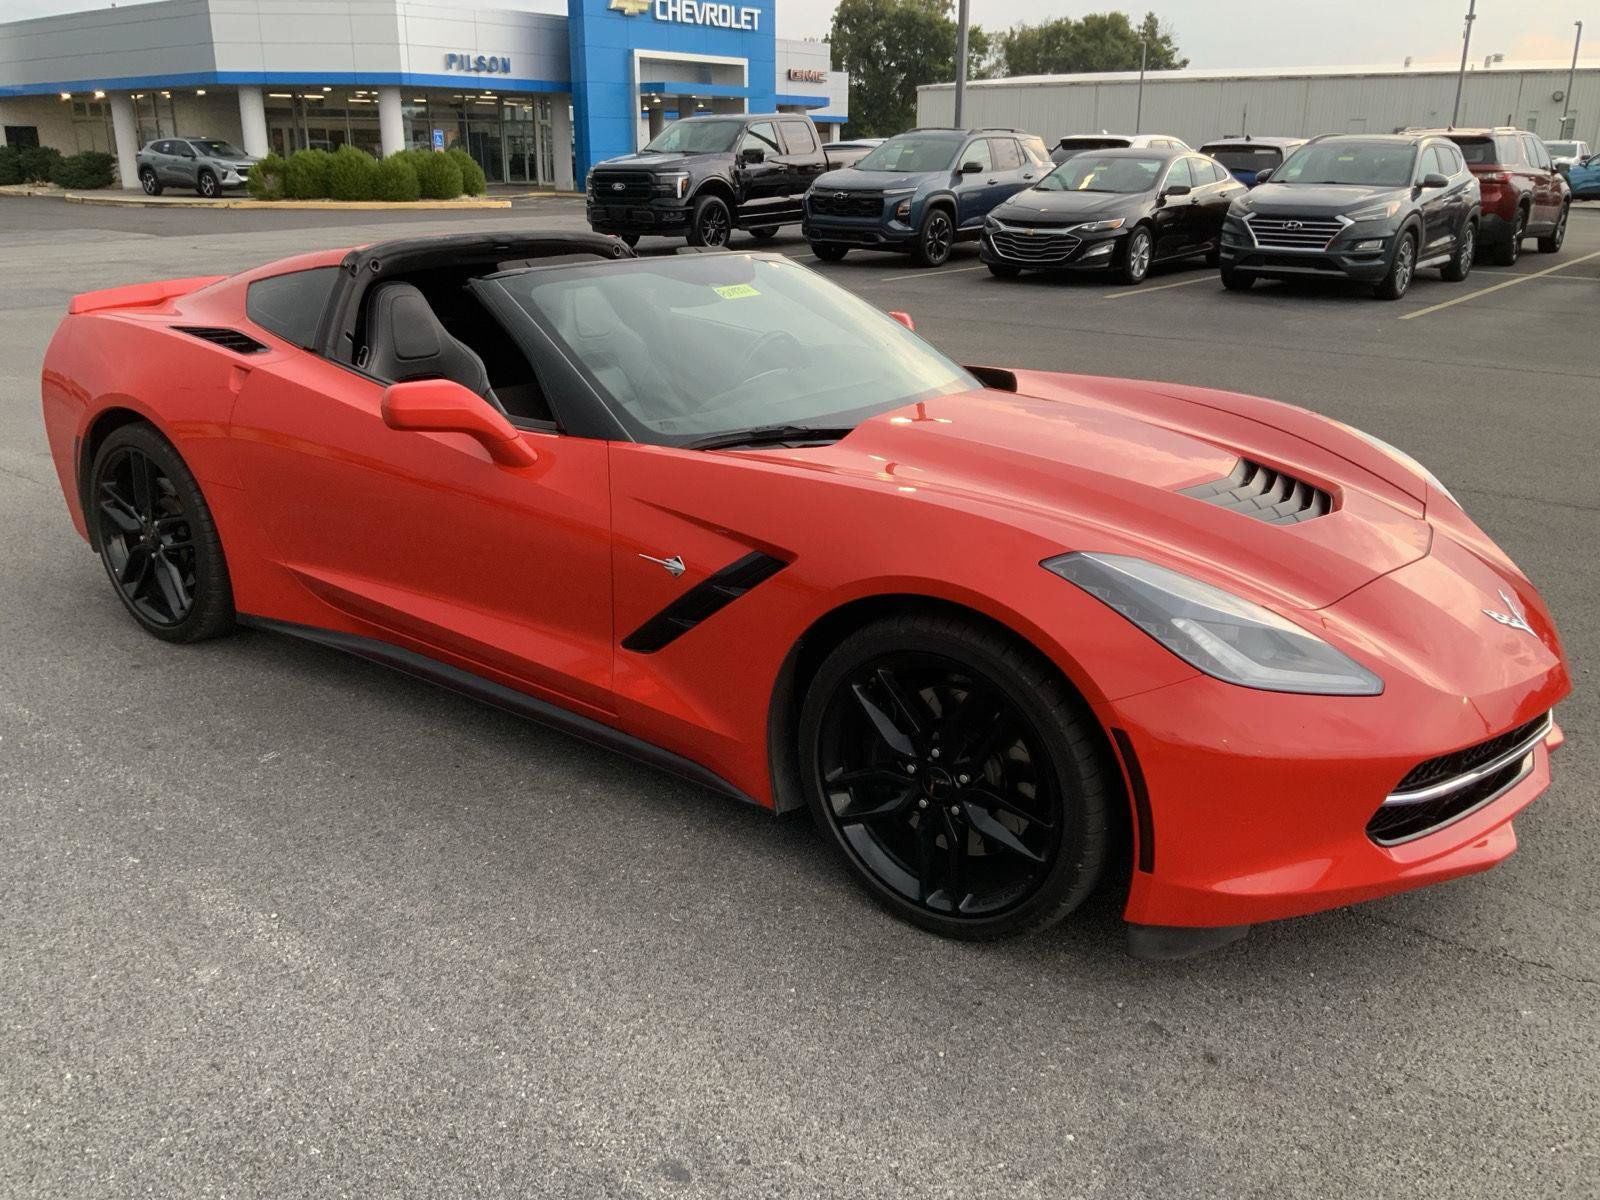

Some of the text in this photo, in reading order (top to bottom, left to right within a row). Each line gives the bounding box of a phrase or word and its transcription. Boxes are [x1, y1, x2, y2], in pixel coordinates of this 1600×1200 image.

[655, 0, 761, 31] CHEVROLET
[446, 53, 511, 73] PILSON
[788, 69, 827, 83] GMC
